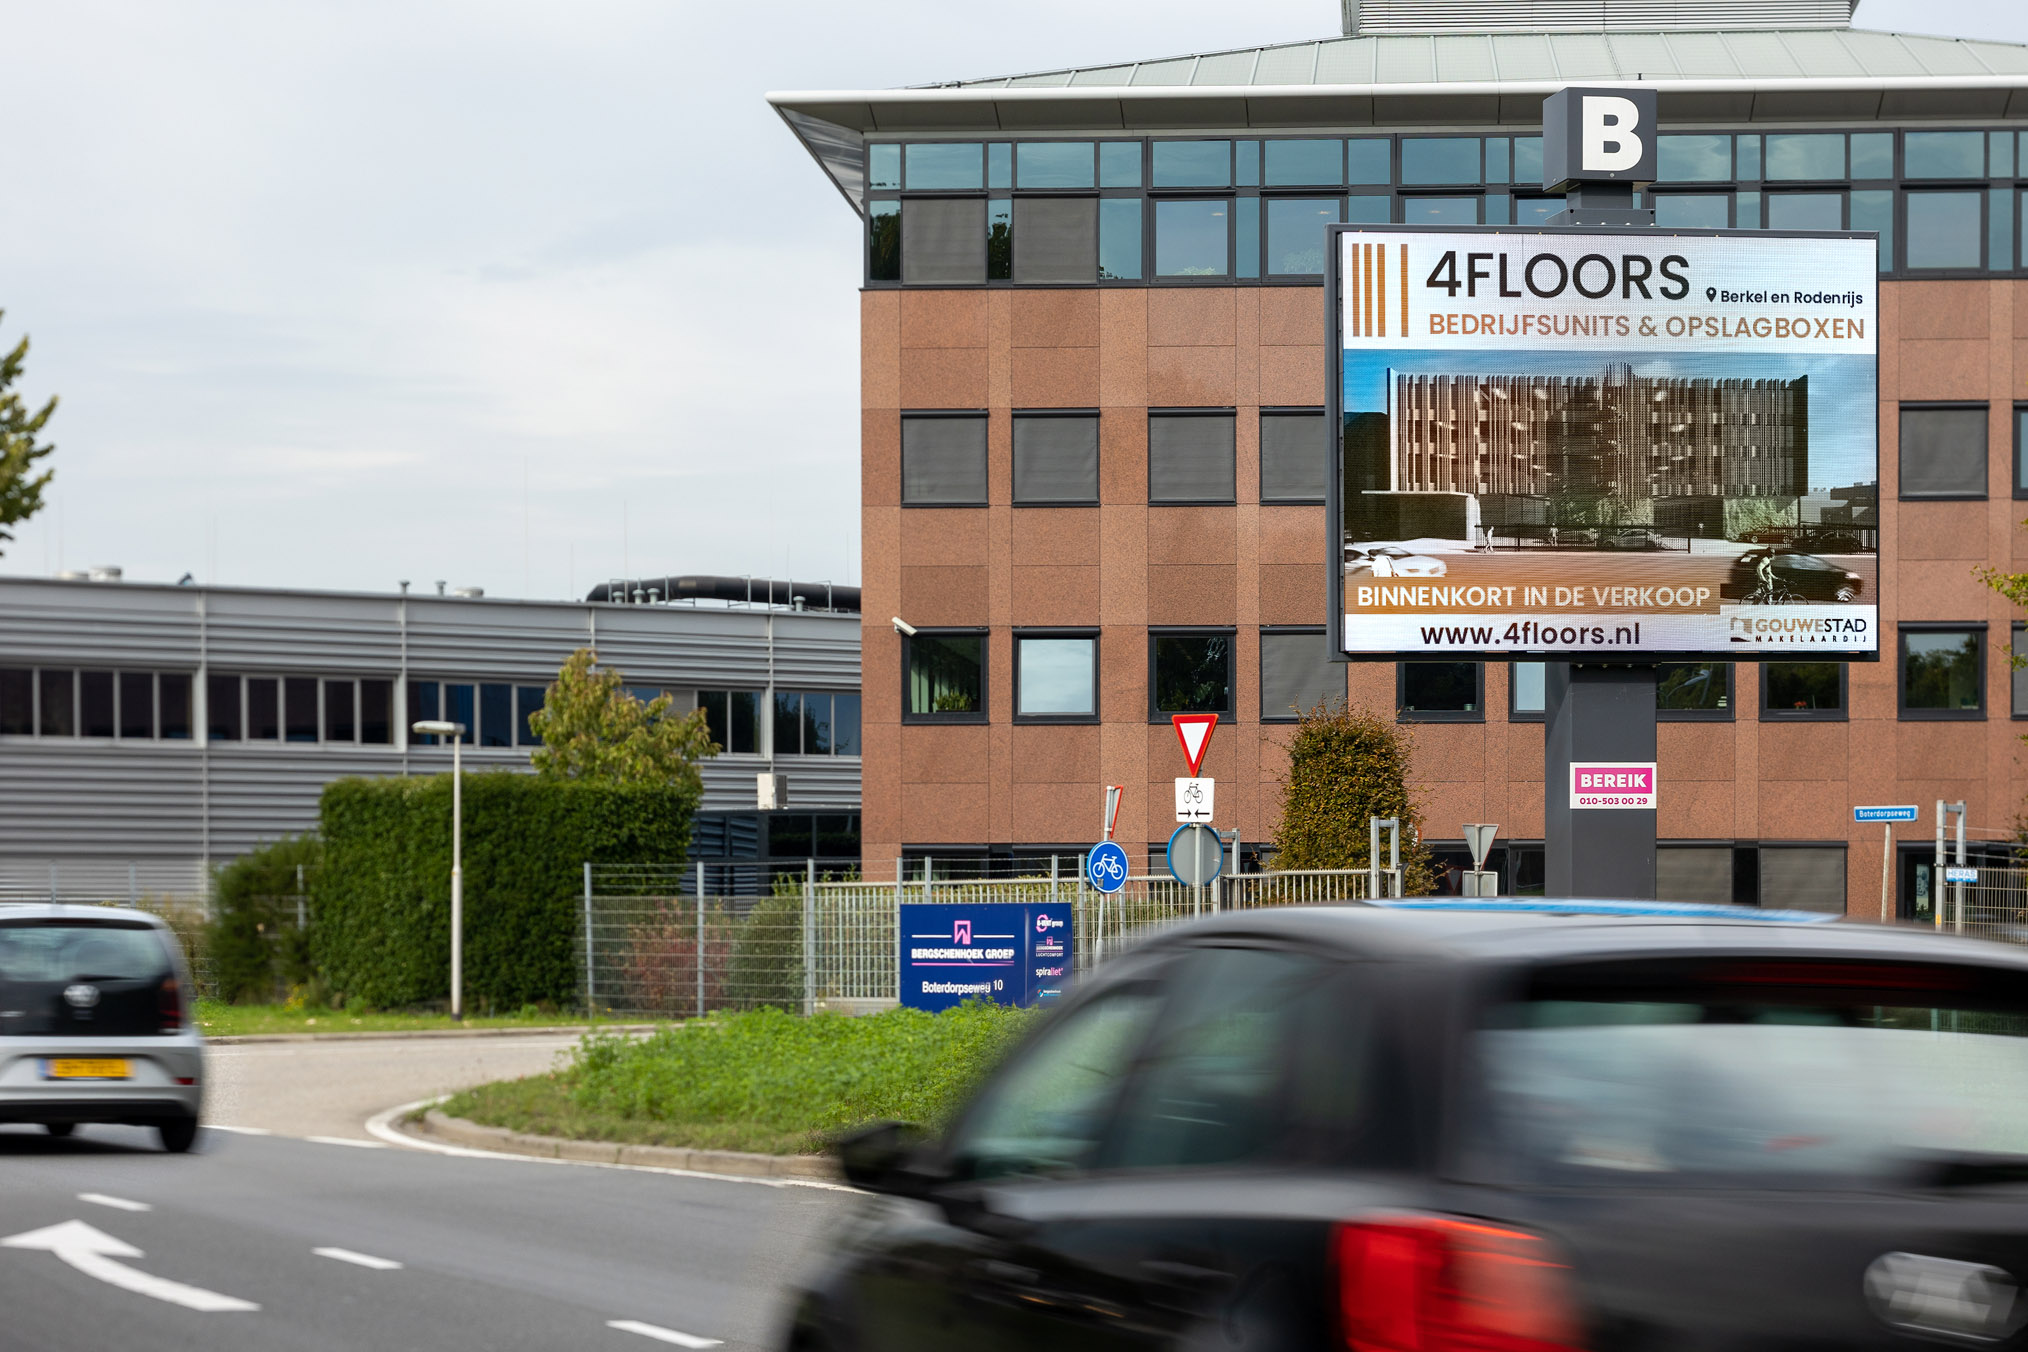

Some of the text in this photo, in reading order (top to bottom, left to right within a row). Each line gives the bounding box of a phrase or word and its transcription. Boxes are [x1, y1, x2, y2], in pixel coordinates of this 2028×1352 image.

[1582, 95, 1643, 172] B
[1426, 250, 1691, 300] 4FLOORS
[1721, 289, 1864, 308] Berkel en Rodenrijs
[1429, 313, 1865, 340] BEDRIJFSUNITS & OPSLAGBOXEN
[1357, 586, 1711, 607] BINNENKORT IN DE VERKOOP
[1420, 622, 1641, 645] www.4floors.nl
[1755, 618, 1867, 633] GOUWESTAD
[1755, 635, 1867, 643] MAKELAARDIJ
[1581, 773, 1647, 789] BEREIK
[1580, 797, 1648, 806] 010-503 00 29
[1859, 810, 1911, 818] Boterdorpseweg
[1947, 869, 1977, 878] HERAS
[911, 948, 1015, 960] BERGSCHENHOEK GROEP
[922, 979, 1003, 995] Boterdorpseweg 10
